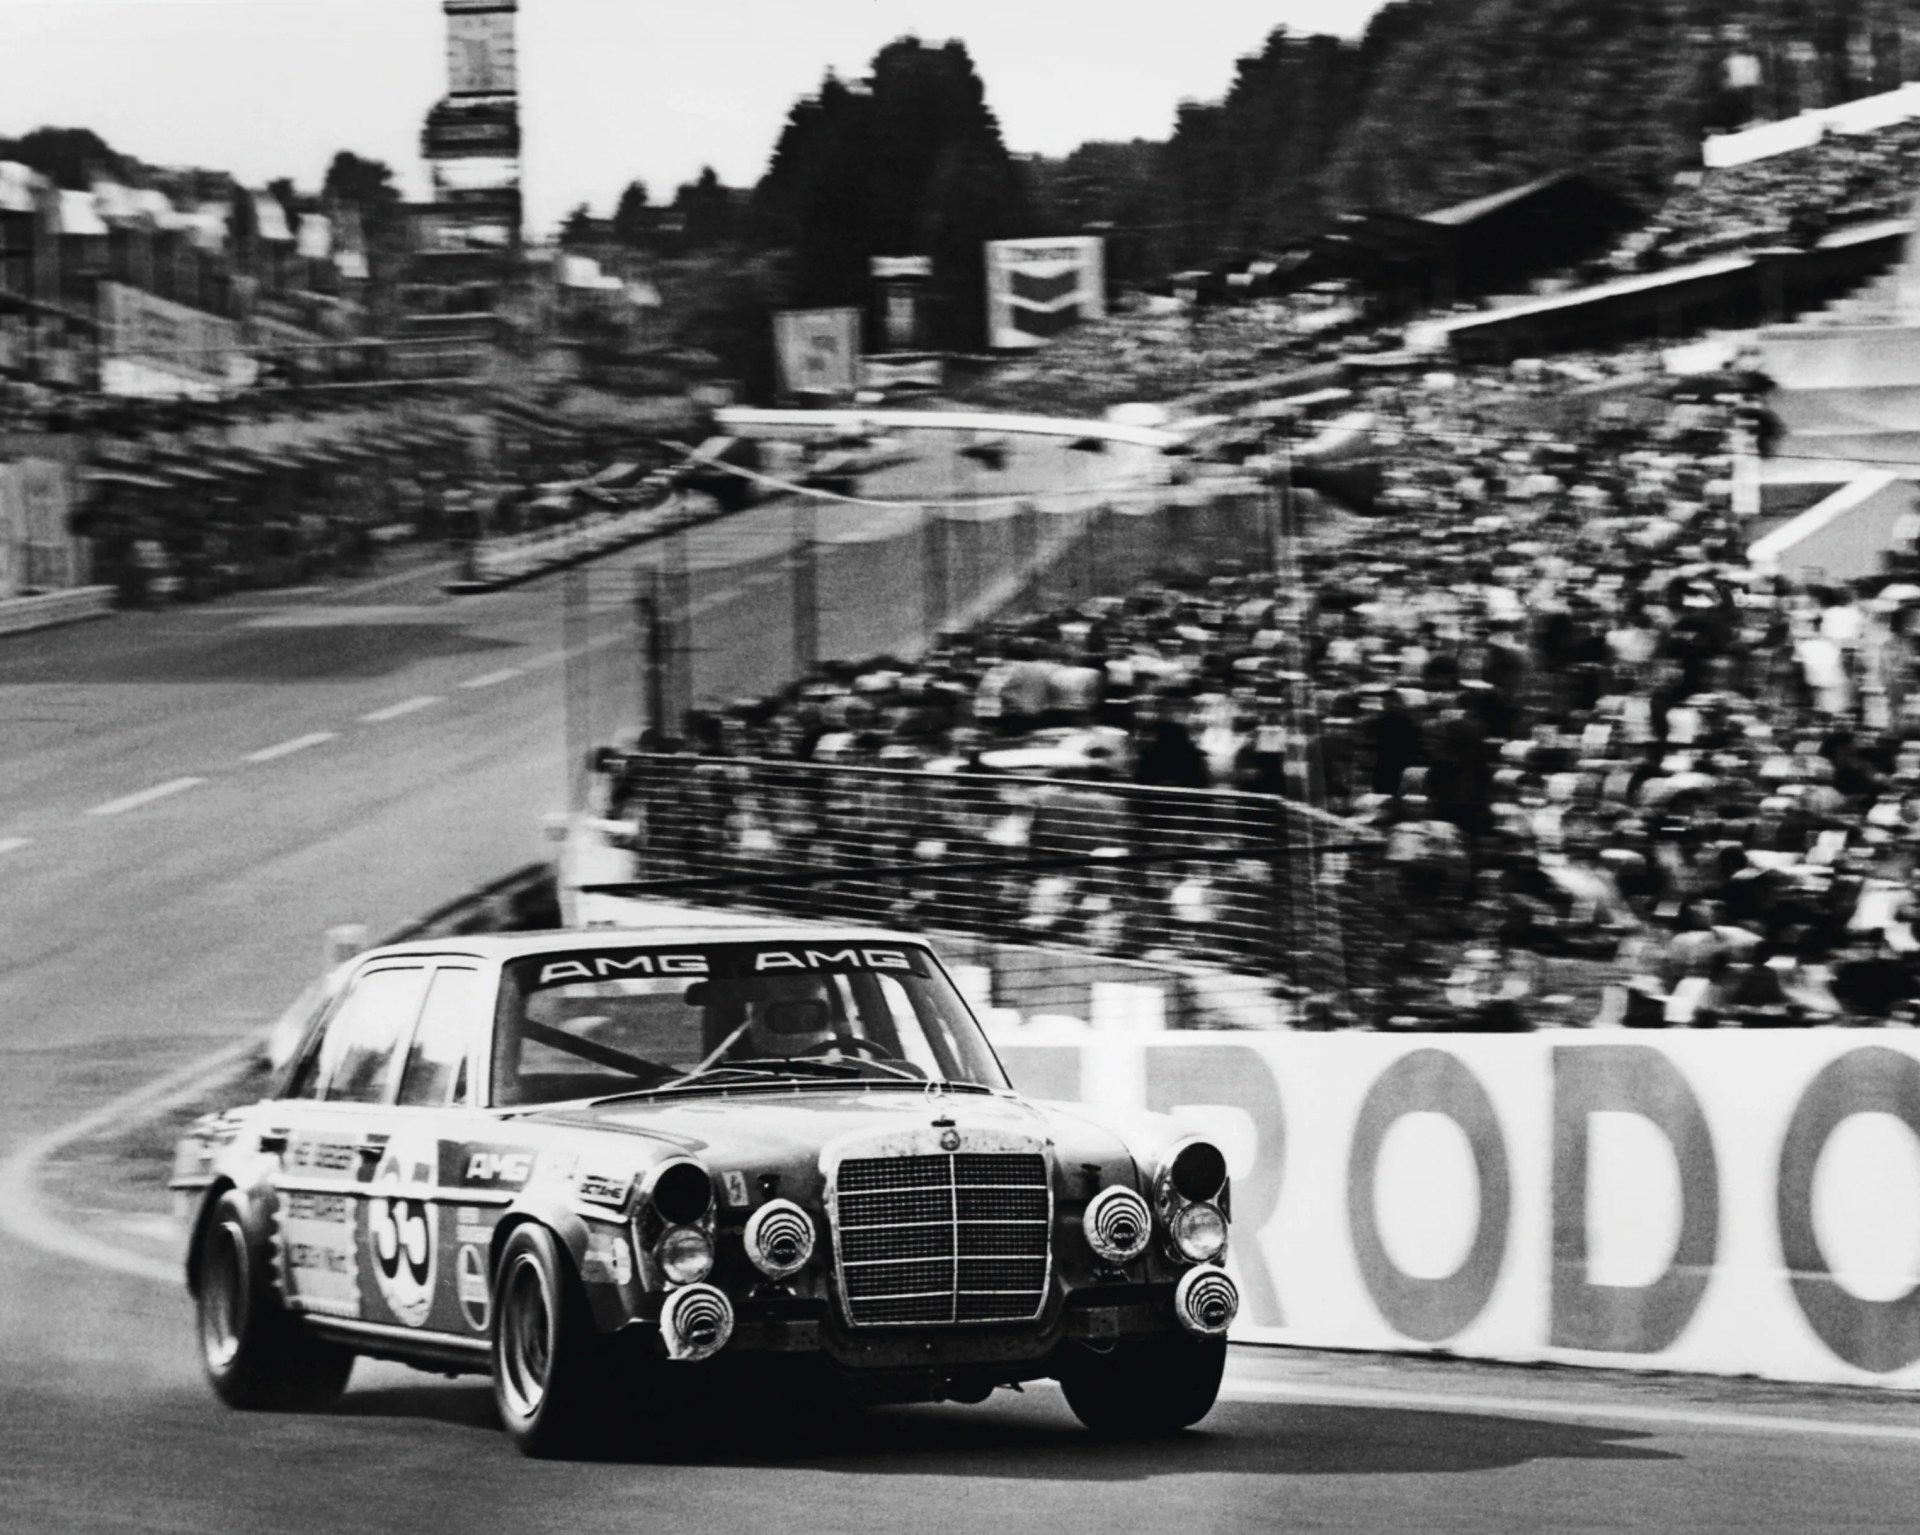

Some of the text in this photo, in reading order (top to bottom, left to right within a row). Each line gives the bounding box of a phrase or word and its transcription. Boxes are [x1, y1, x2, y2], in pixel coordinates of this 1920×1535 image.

[541, 948, 911, 983] AMG AMG
[465, 1152, 534, 1183] AMG
[996, 1043, 1920, 1374] RODO
